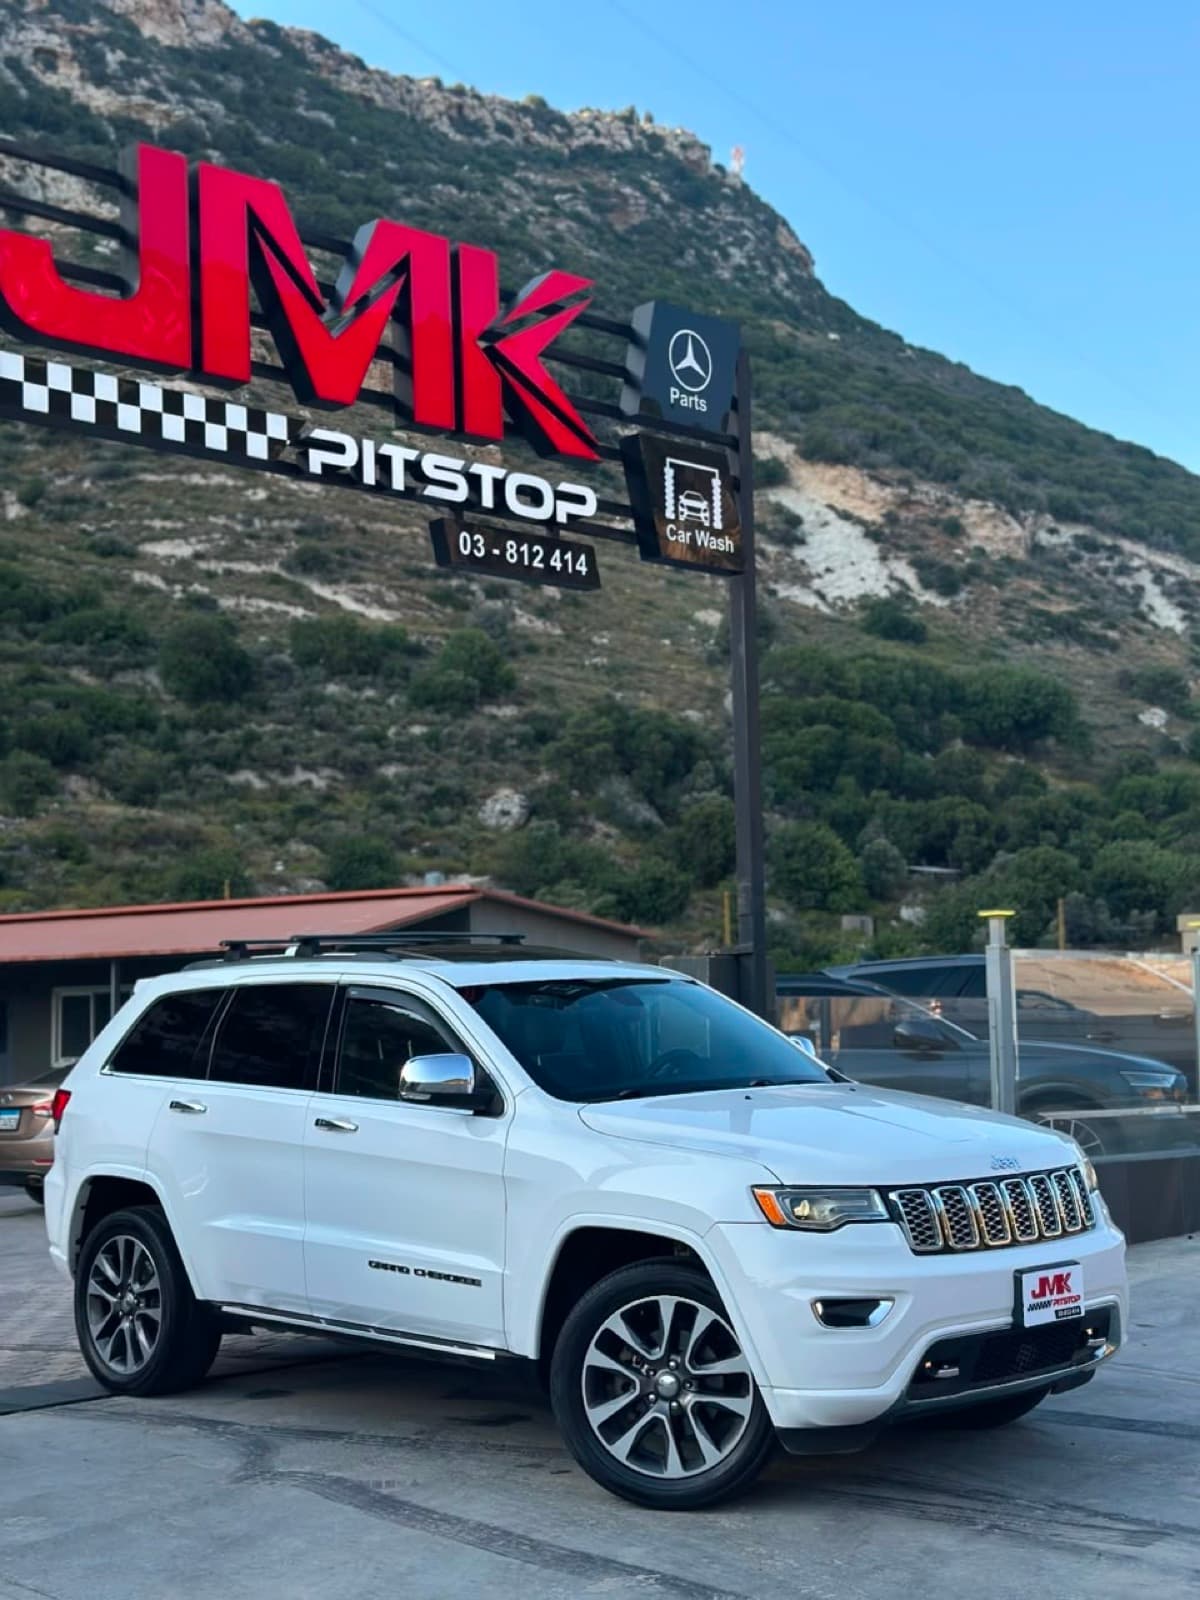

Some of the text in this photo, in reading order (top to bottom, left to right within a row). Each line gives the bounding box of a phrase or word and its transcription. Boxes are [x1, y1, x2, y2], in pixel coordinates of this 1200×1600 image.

[0, 143, 601, 461] JMK
[670, 387, 707, 412] Parts
[308, 429, 598, 524] PITSTOP
[459, 531, 486, 557] 03
[506, 543, 545, 570] 812
[550, 549, 588, 577] 414
[666, 524, 735, 553] Car Wash
[1031, 1272, 1071, 1299] JMK
